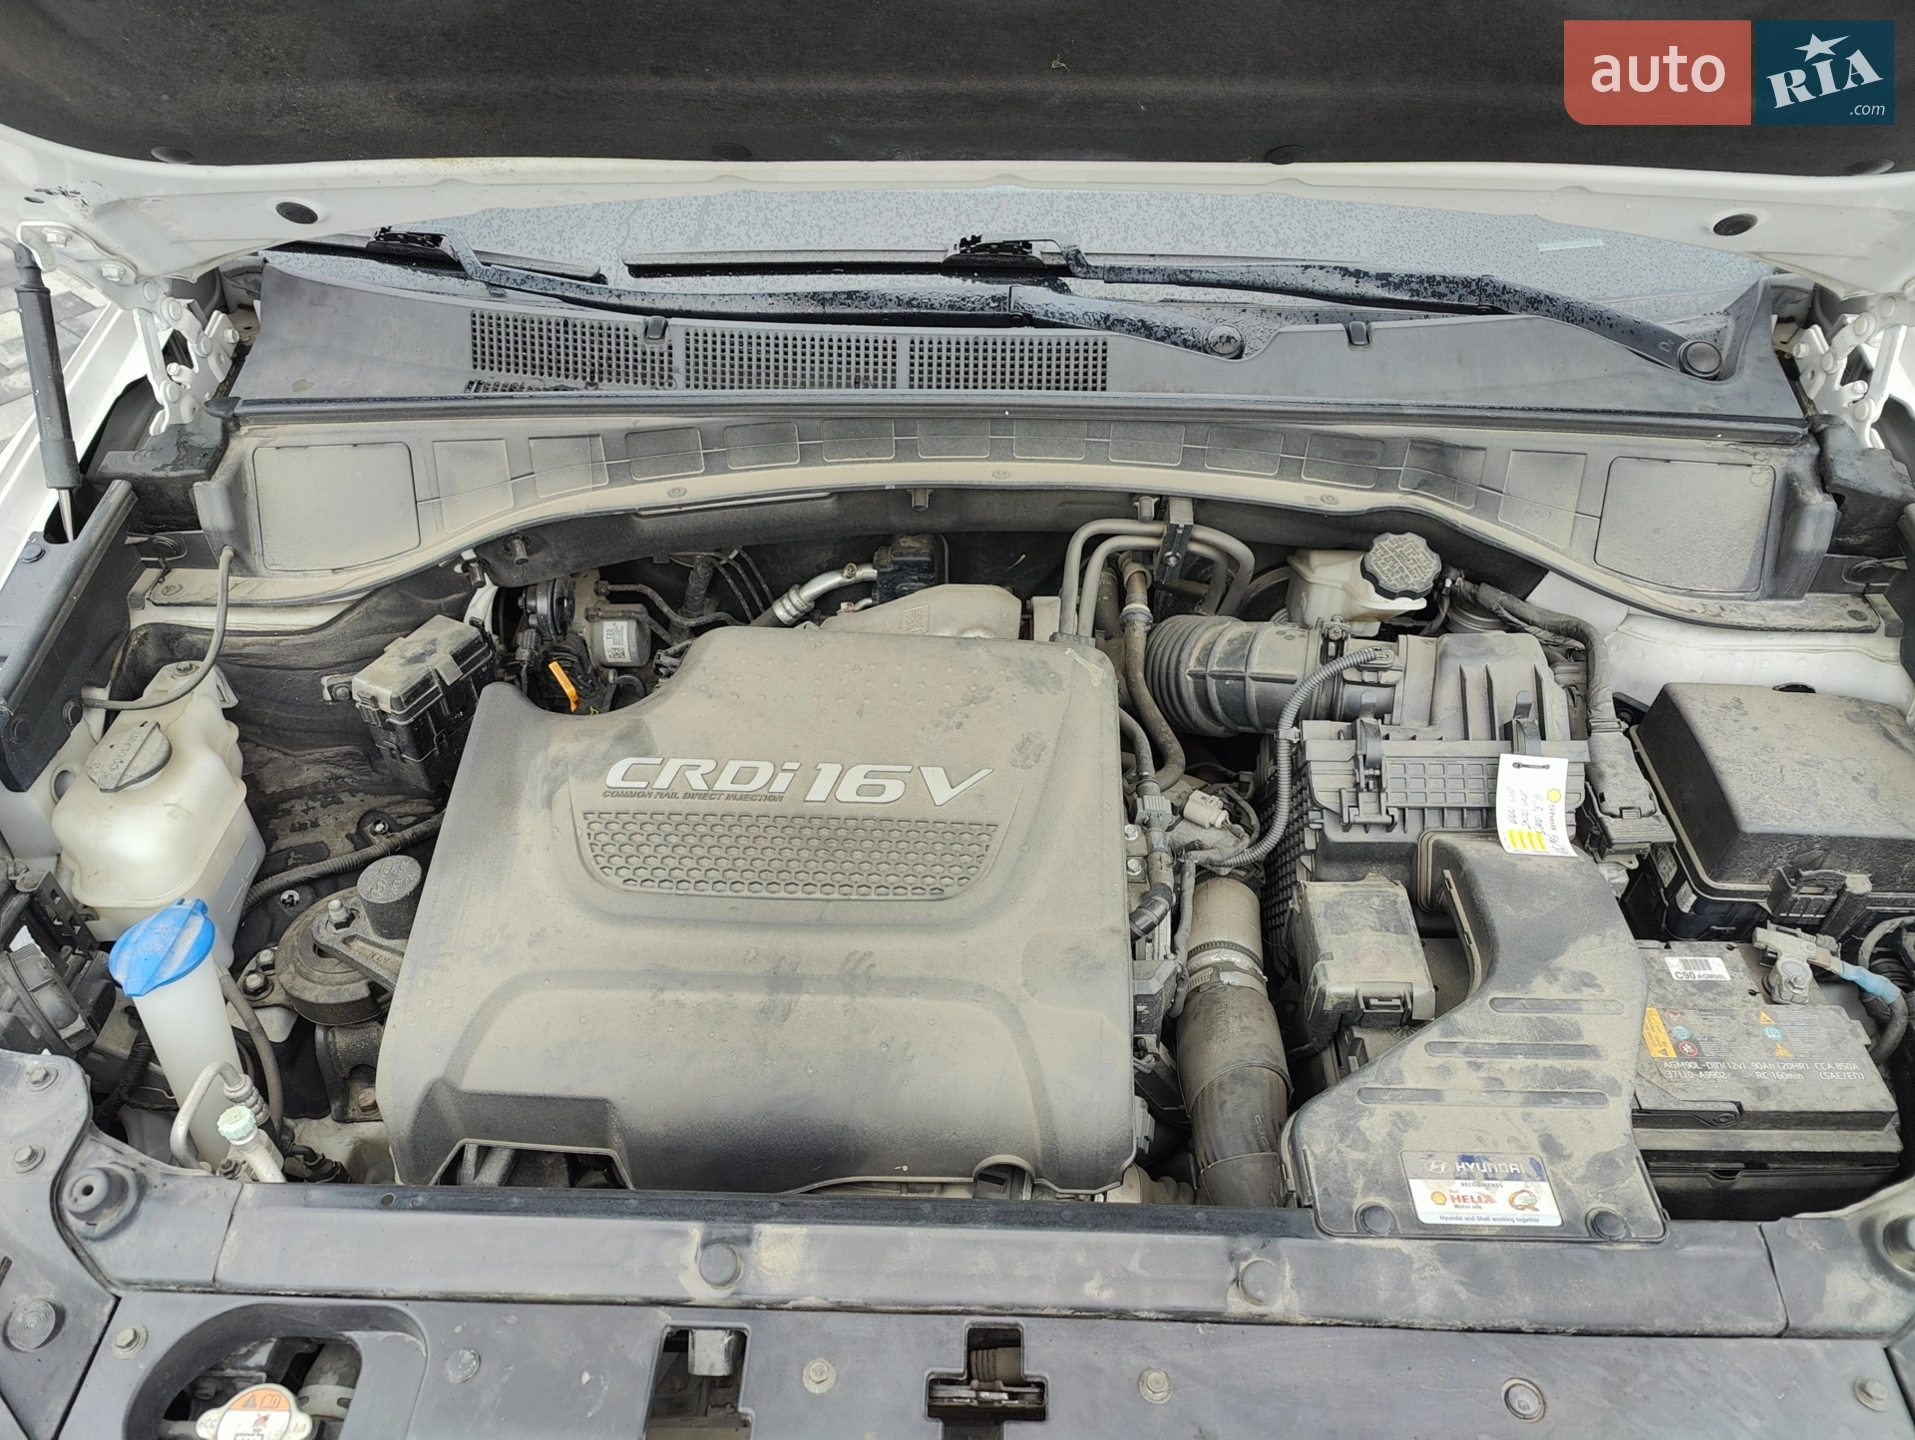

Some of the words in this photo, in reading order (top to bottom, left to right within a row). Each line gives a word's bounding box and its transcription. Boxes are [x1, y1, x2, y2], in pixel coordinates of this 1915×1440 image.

[605, 757, 801, 793] CRDi
[602, 790, 653, 799] COMMON
[653, 791, 680, 800] RAIL
[681, 792, 724, 801] DIRECT
[725, 793, 785, 803] INJECTION
[1549, 804, 1557, 831] Shell
[1675, 971, 1696, 980] C90
[1750, 1061, 1776, 1070] 90Ah
[1778, 1062, 1810, 1071] (20HR)
[1814, 1062, 1834, 1071] CCA
[1835, 1062, 1860, 1071] 850A
[1666, 1070, 1728, 1080] 37110-A9902
[1755, 1071, 1770, 1080] RC
[1771, 1071, 1805, 1080] 160min
[1455, 1162, 1525, 1174] HYUNDAI
[1450, 1193, 1497, 1204] HELIX
[1440, 1215, 1463, 1223] Hyundai
[1492, 1216, 1515, 1224] working
